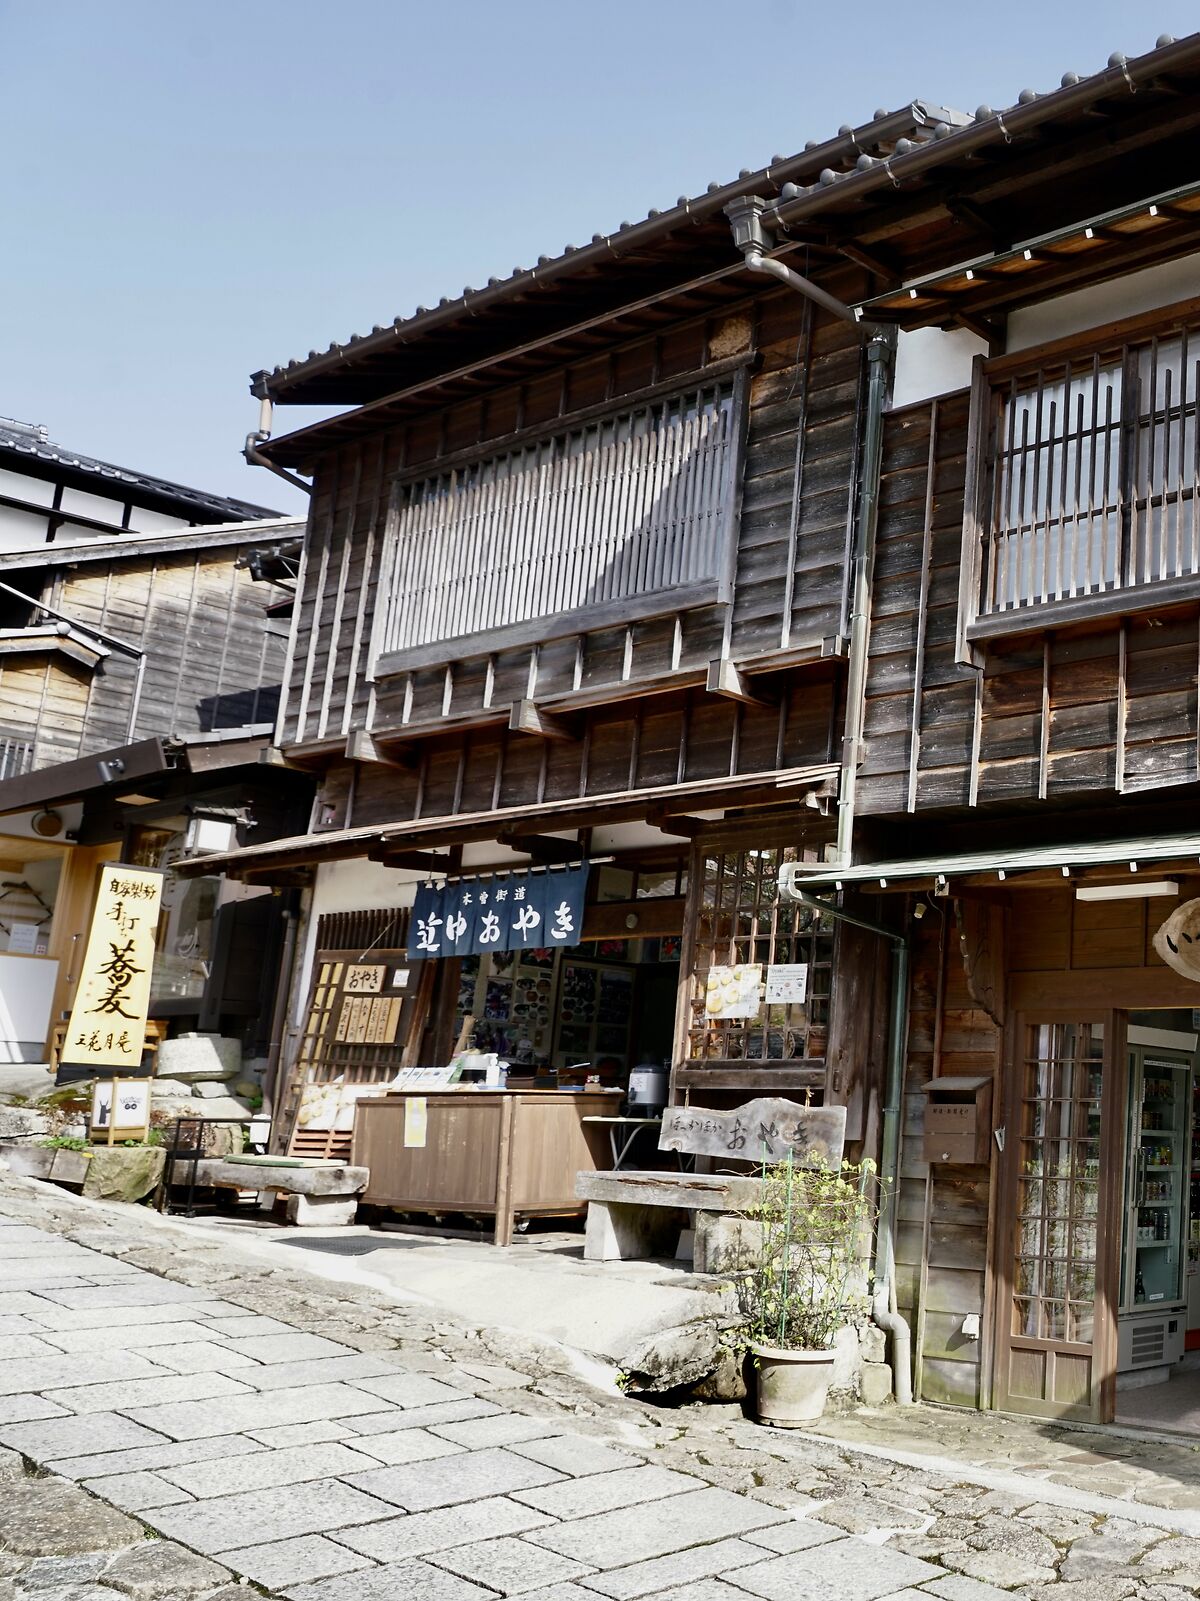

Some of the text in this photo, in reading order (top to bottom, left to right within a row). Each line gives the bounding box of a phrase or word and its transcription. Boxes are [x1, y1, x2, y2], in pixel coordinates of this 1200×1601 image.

[109, 878, 157, 899] 自家製粉
[462, 886, 527, 905] 木曽街道
[84, 939, 147, 1020] 蕎麦
[349, 967, 379, 990] おやき
